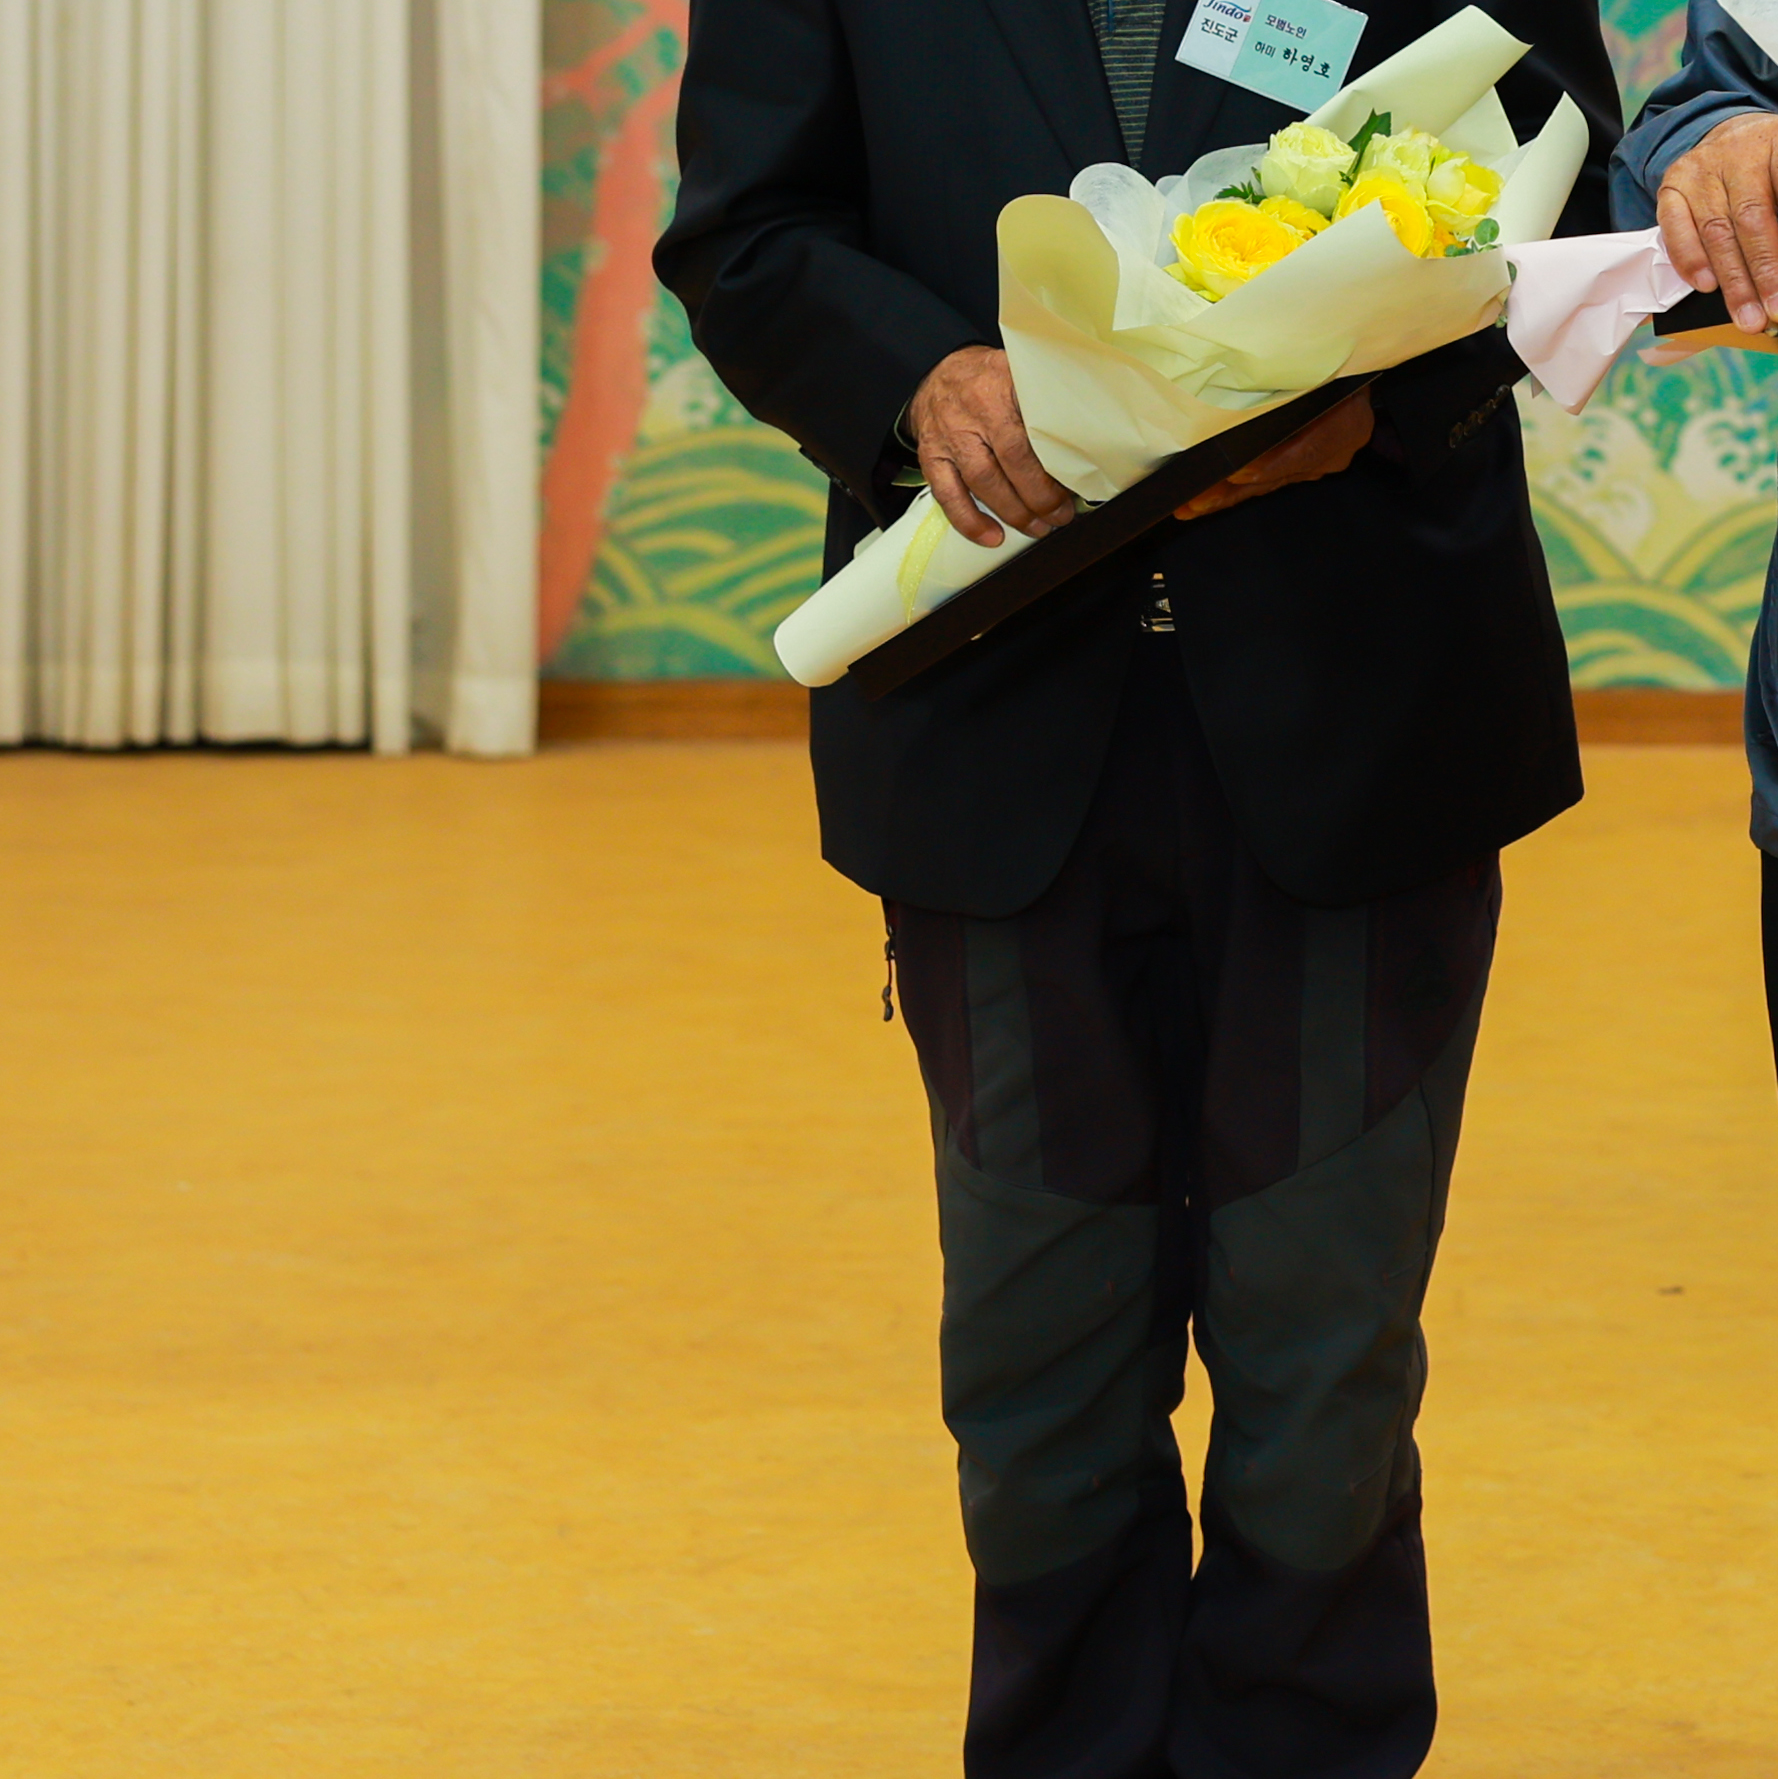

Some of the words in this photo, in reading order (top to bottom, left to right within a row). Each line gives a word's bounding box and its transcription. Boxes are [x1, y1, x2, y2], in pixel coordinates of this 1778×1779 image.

[1201, 18, 1238, 43] 진도군
[1265, 14, 1307, 39] 모범노인
[1283, 47, 1330, 79] 하영호
